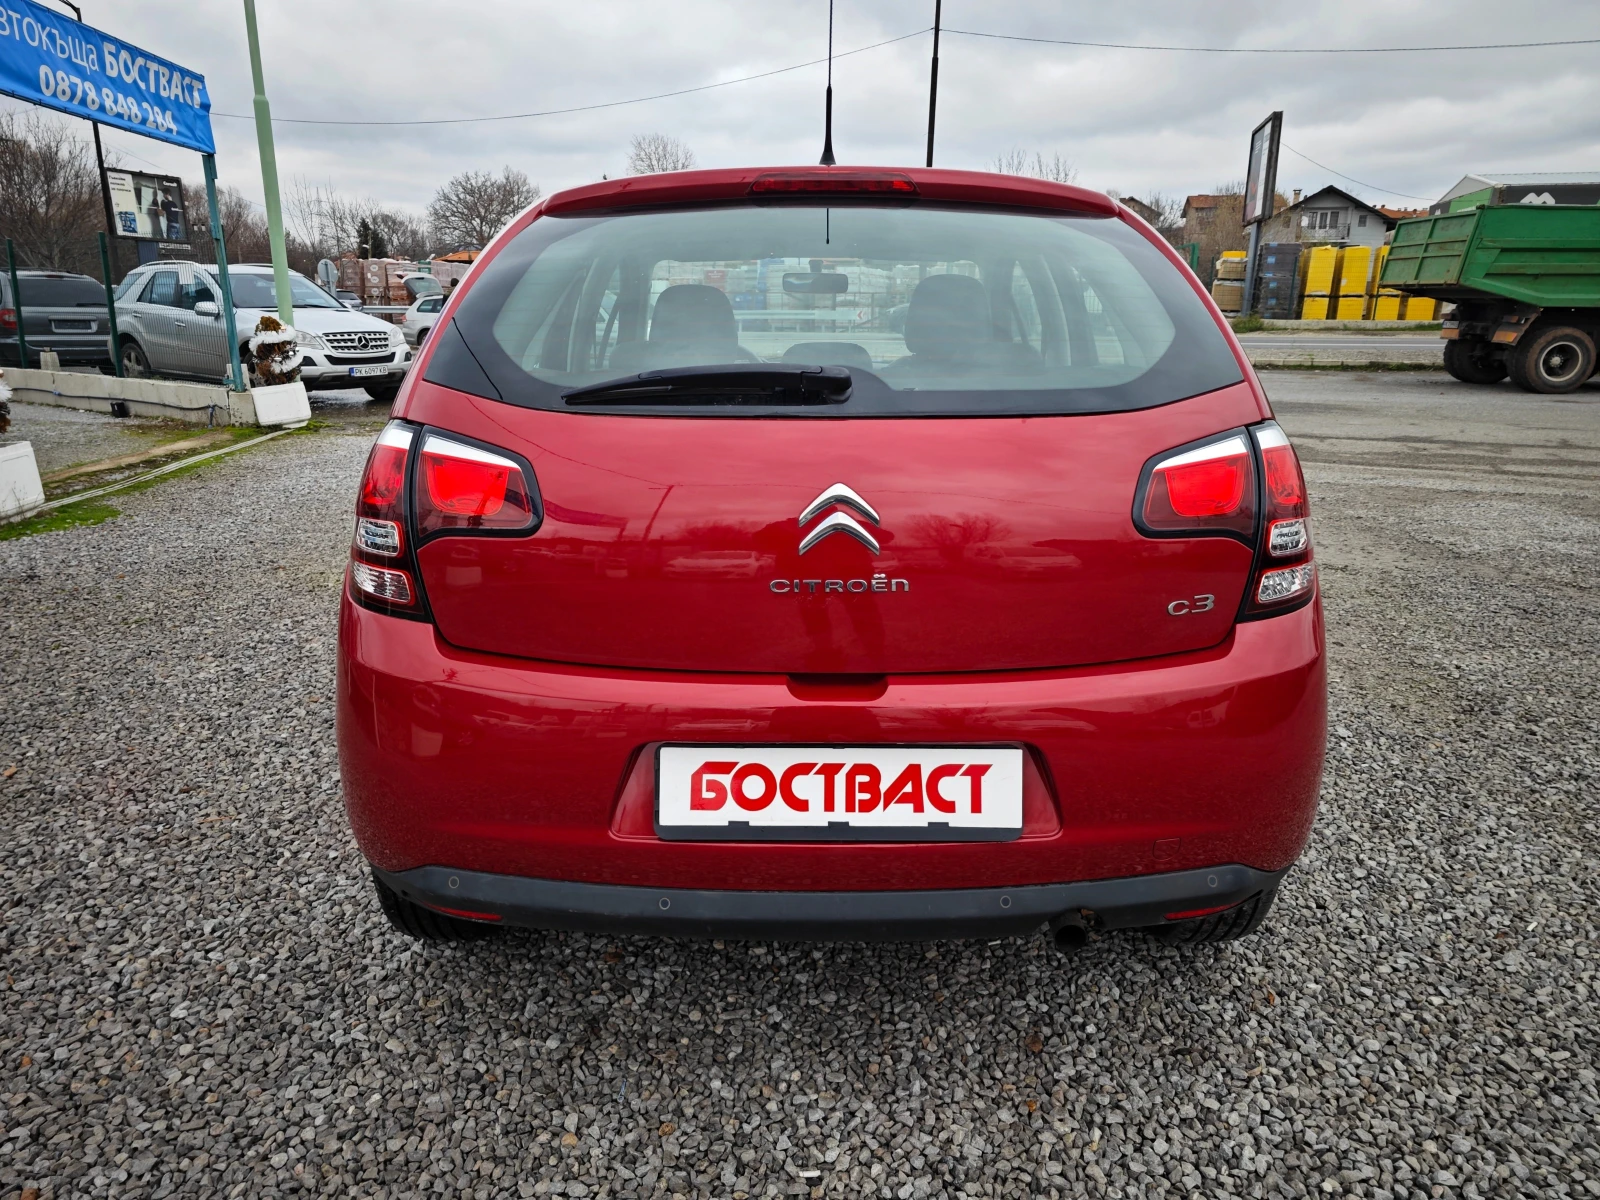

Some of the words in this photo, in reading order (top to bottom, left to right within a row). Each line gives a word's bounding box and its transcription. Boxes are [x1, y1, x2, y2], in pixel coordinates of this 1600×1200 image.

[39, 65, 100, 111] 0878
[102, 88, 142, 124] 848
[143, 102, 178, 136] 284
[103, 42, 202, 108] БОСТВАСТ
[690, 761, 993, 814] БОСТВАСТ
